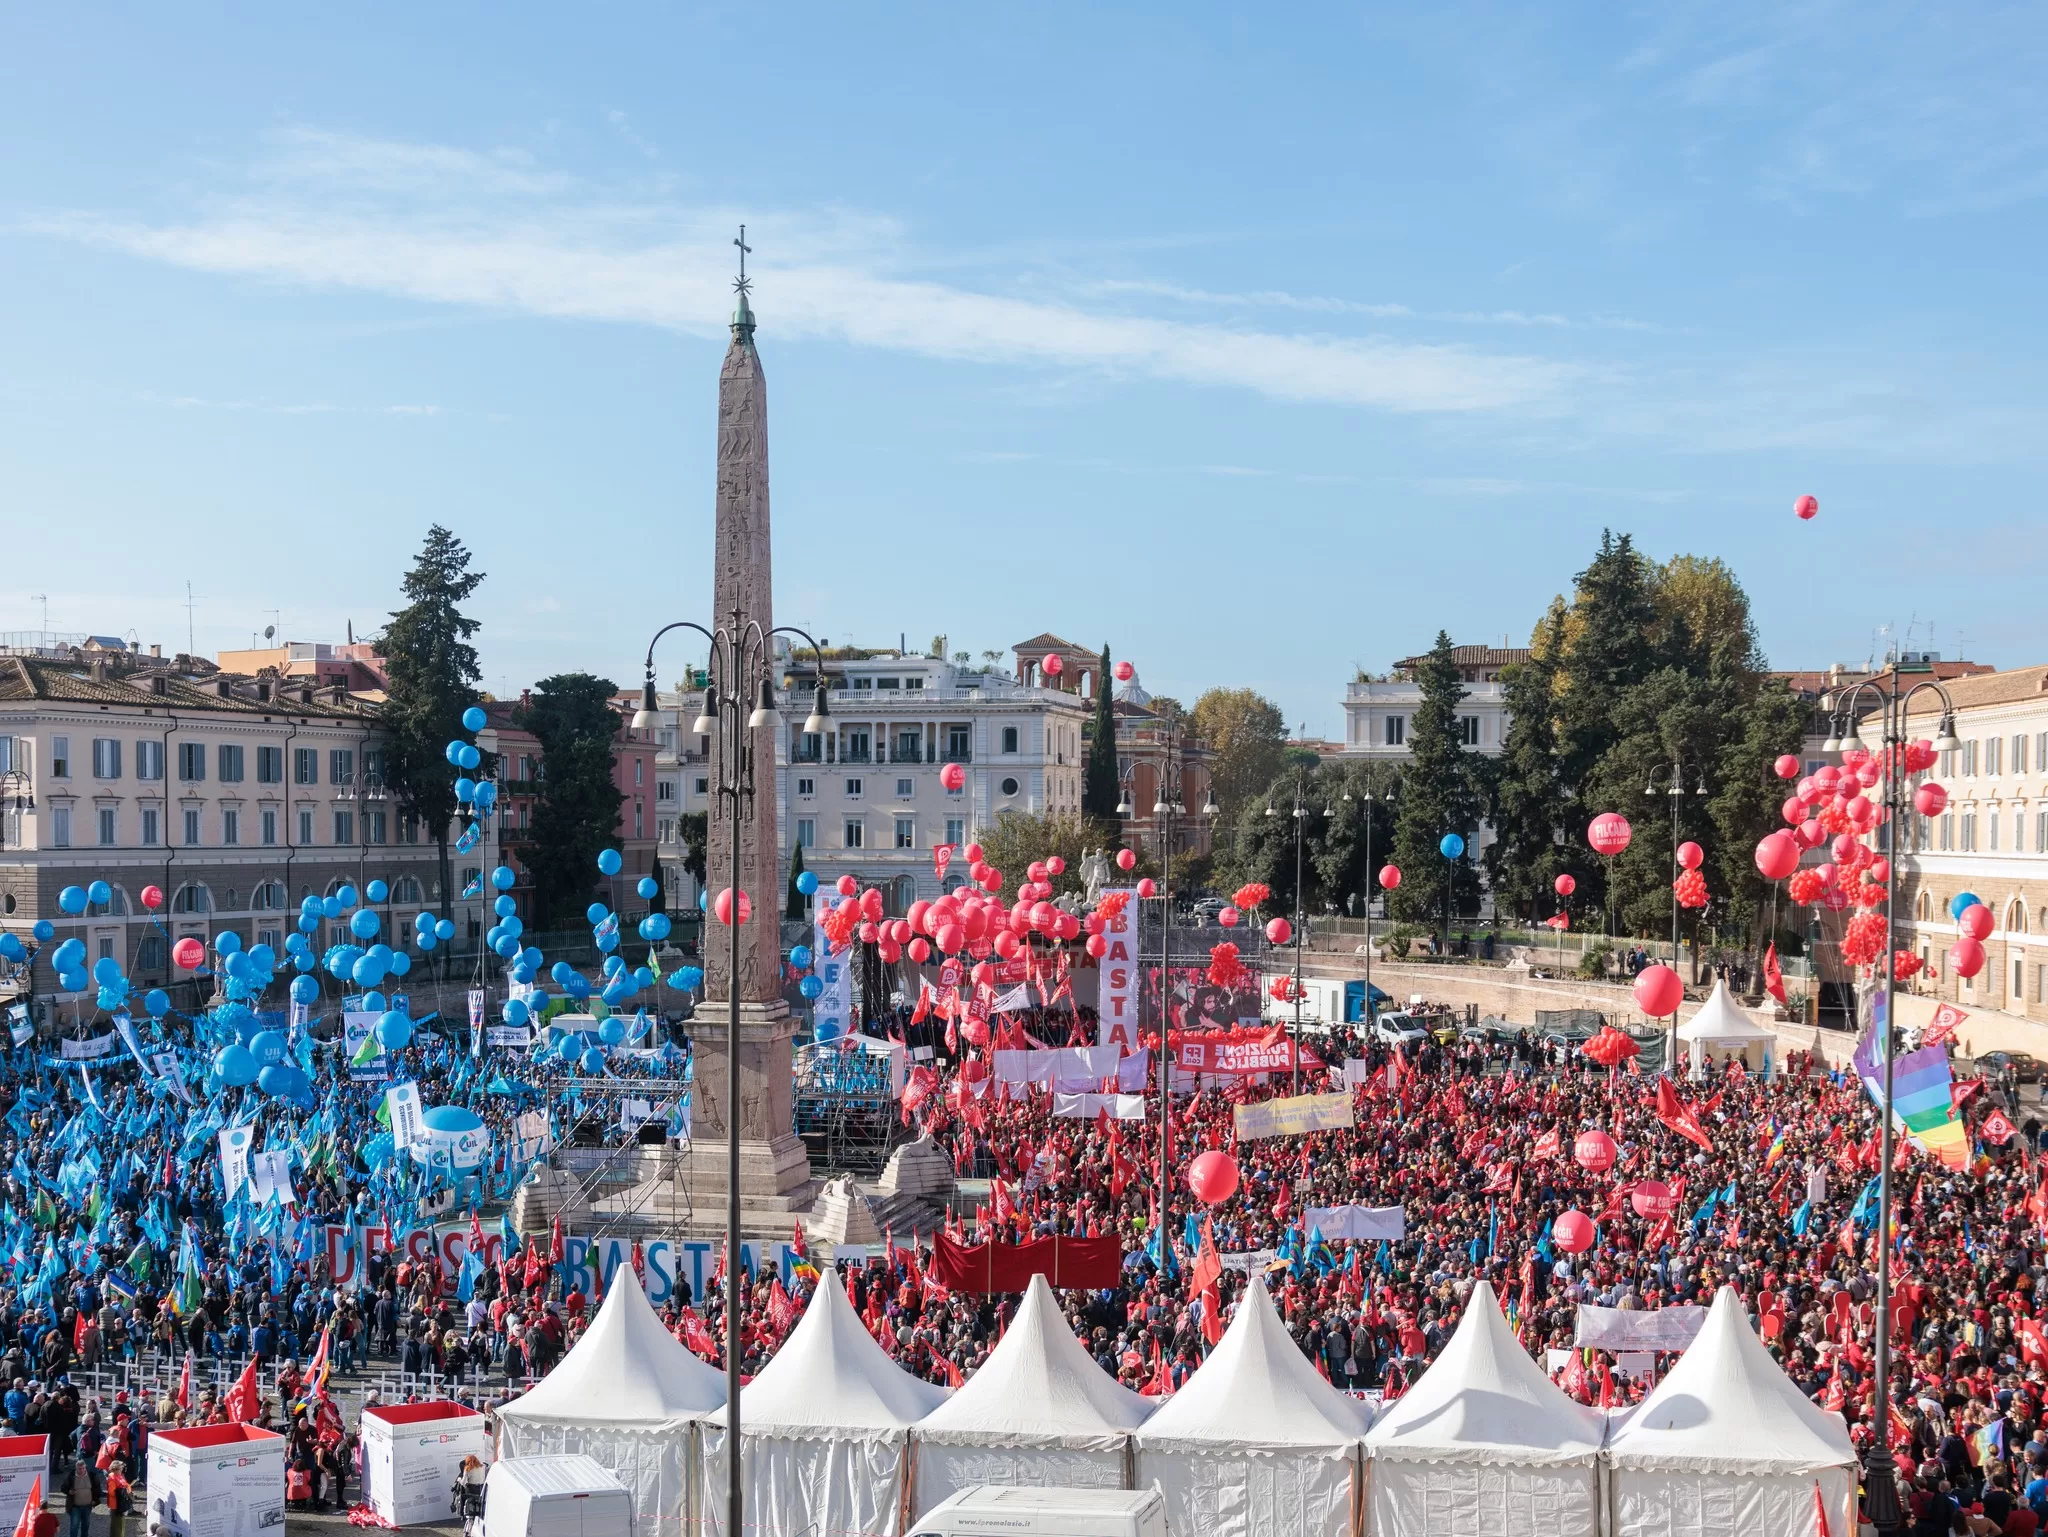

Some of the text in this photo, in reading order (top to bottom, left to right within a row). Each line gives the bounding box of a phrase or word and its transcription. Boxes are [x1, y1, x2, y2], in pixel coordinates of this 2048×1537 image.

[570, 979, 584, 987] UIL
[802, 982, 820, 991] UIL
[265, 1048, 281, 1056] UIL
[466, 1140, 478, 1149] UIL
[1584, 1142, 1607, 1158] CGIL
[1558, 1226, 1574, 1239] CGIL
[837, 1257, 862, 1267] CGIL
[1622, 1369, 1628, 1377] 2
[958, 1519, 1030, 1527] www.fpromalazio.it
